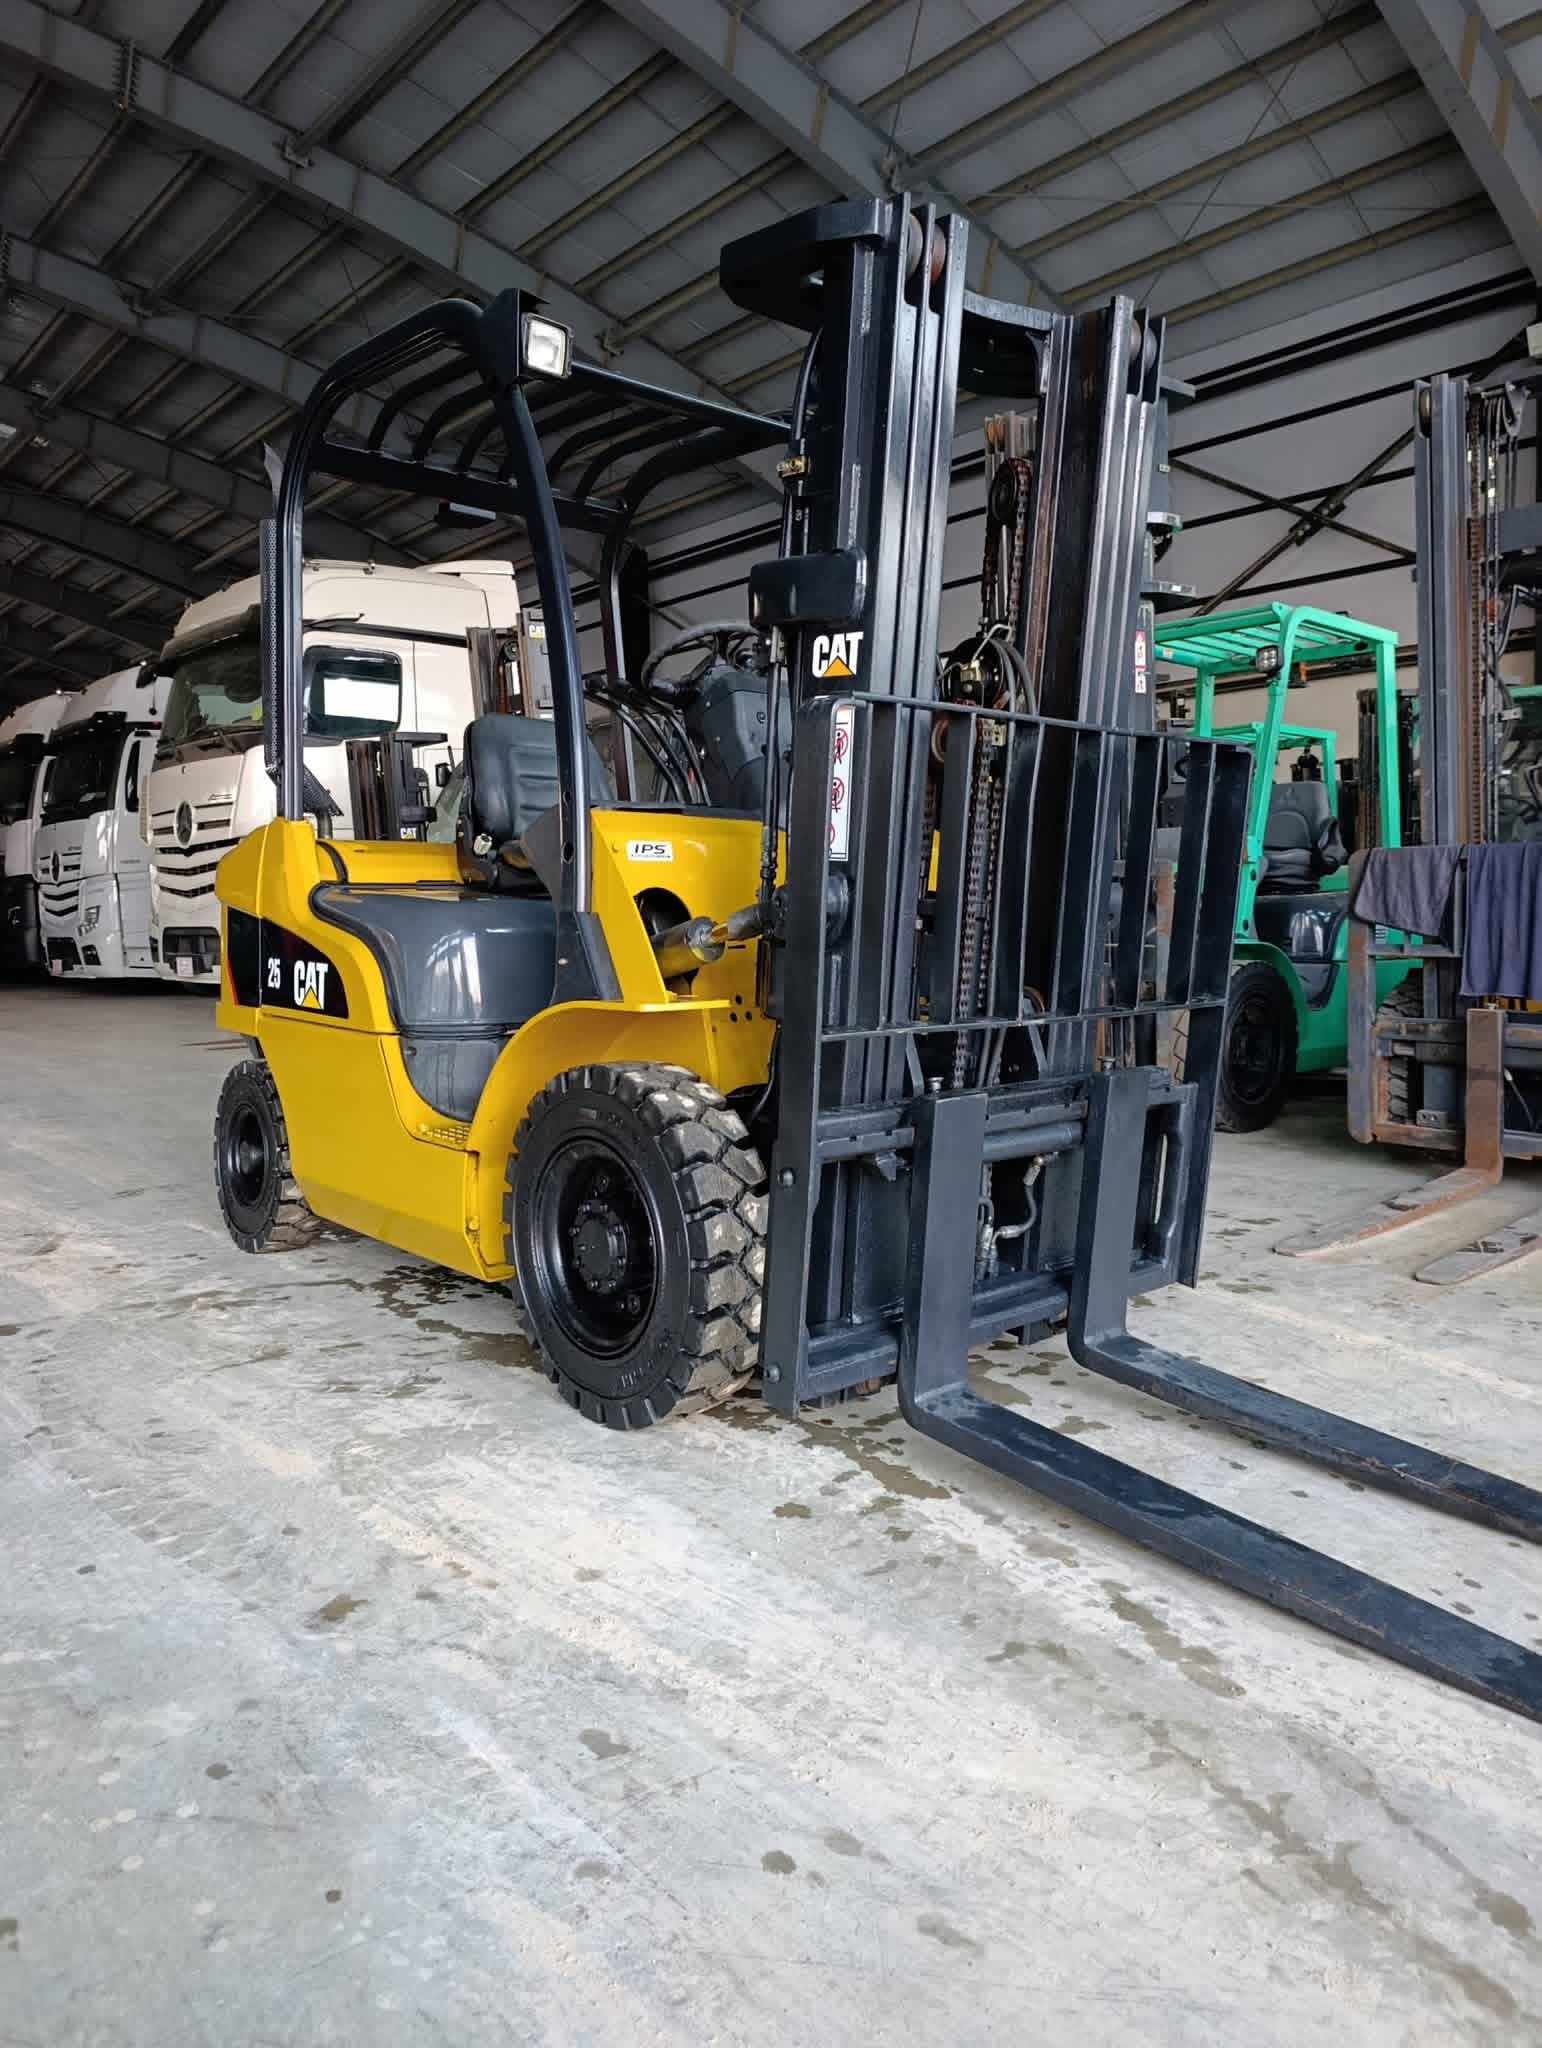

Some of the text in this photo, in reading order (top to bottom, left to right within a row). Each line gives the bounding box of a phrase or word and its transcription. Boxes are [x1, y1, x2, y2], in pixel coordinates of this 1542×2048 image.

[812, 631, 864, 678] CAT
[400, 827, 417, 840] CAT
[635, 844, 666, 855] IPS
[267, 957, 329, 1010] 25 CAT
